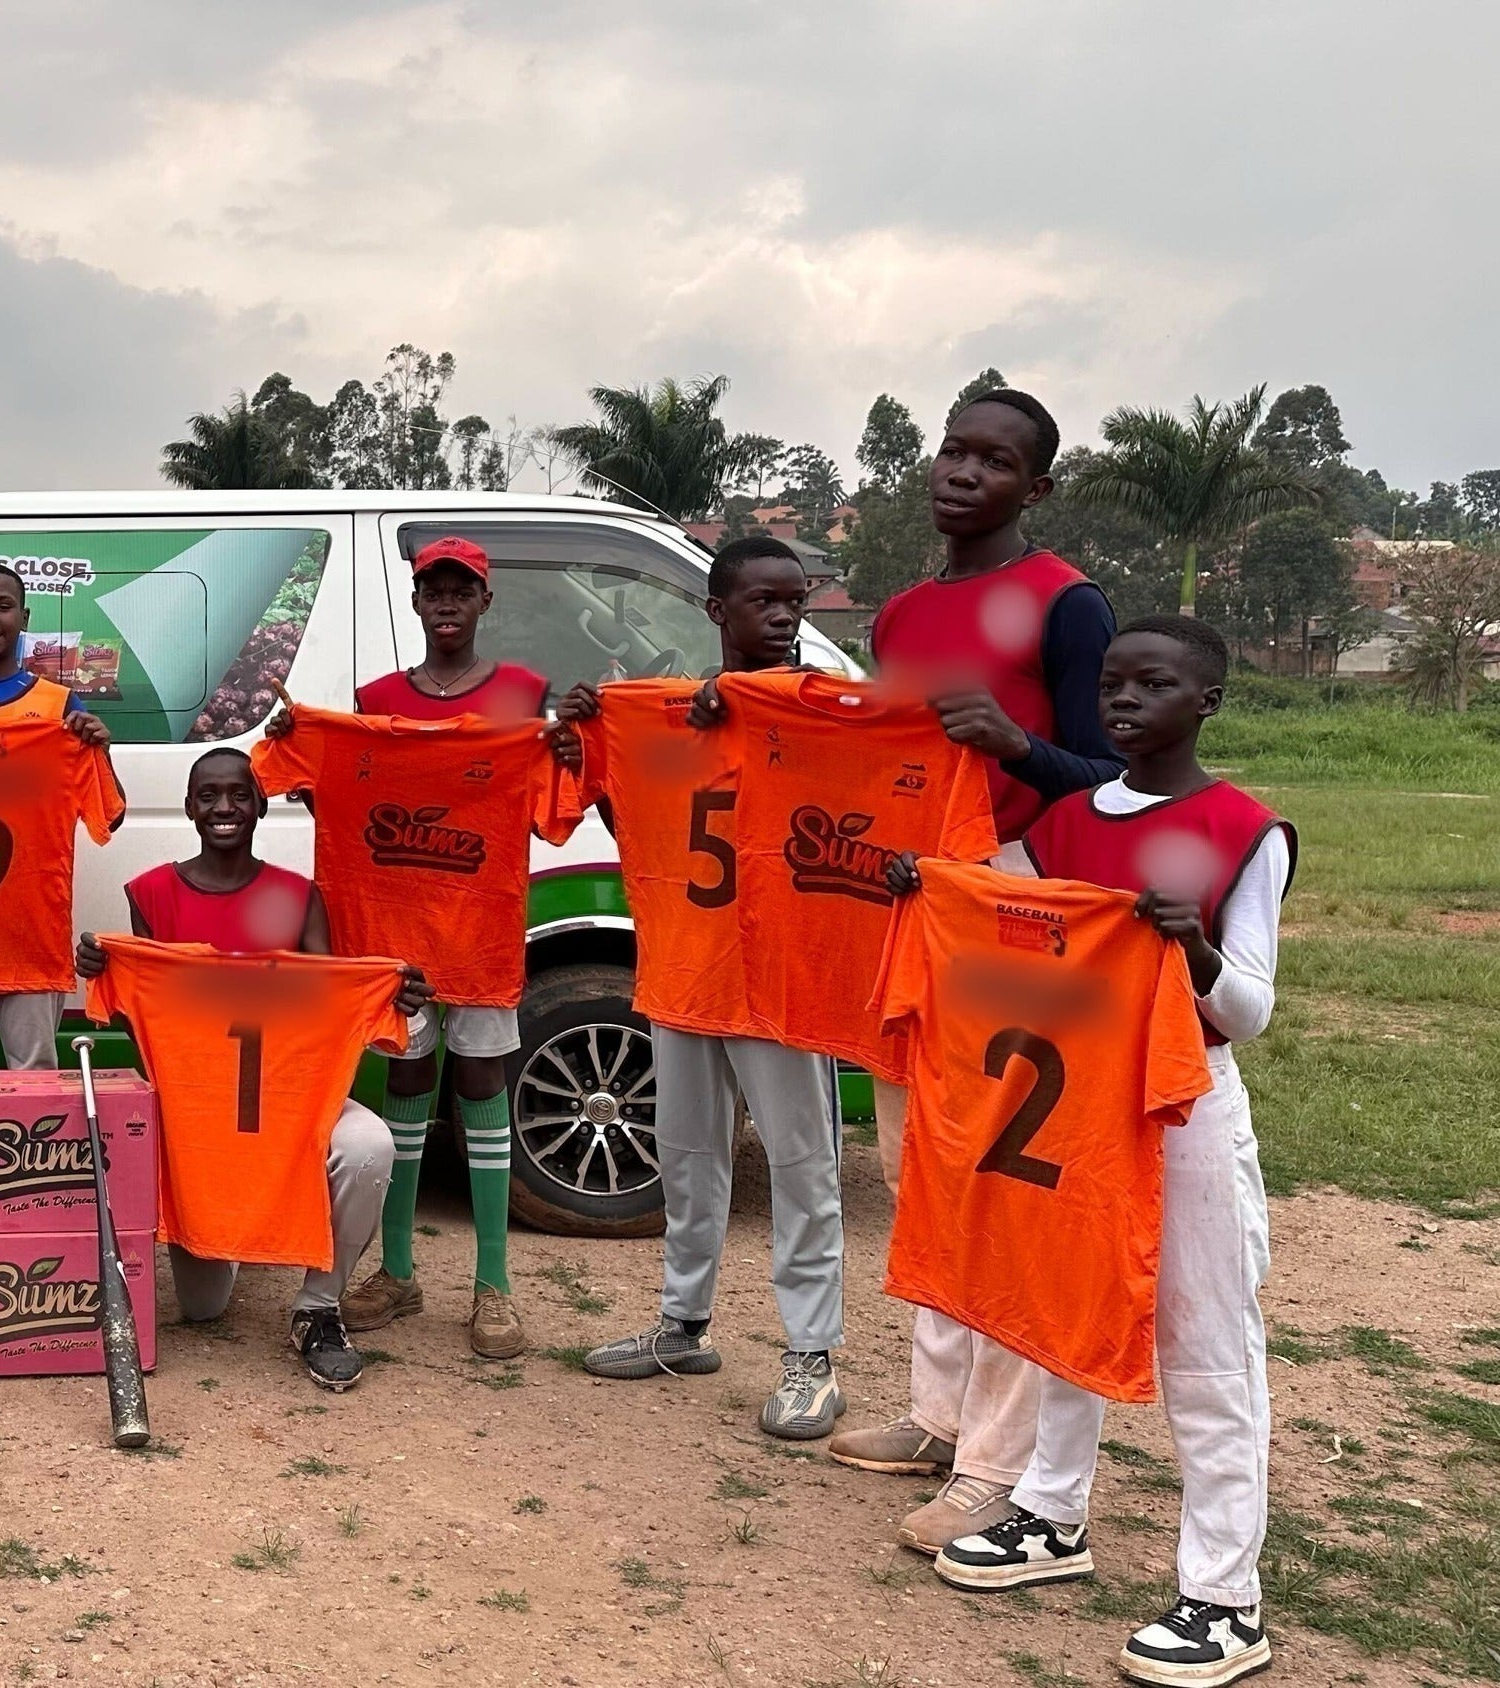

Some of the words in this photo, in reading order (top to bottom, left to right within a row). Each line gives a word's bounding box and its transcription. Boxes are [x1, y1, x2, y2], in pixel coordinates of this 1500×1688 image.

[14, 558, 93, 582] CLOSE,
[24, 581, 73, 595] CLOSER
[367, 804, 485, 859] Sumz
[685, 789, 738, 909] 5
[996, 903, 1067, 926] BASEBALL
[227, 1023, 263, 1134] 1
[974, 1026, 1066, 1191] 2
[2, 1203, 30, 1215] Taste
[32, 1198, 50, 1209] The
[0, 1348, 27, 1360] Taste
[29, 1342, 47, 1353] The
[50, 1339, 98, 1352] Difference
